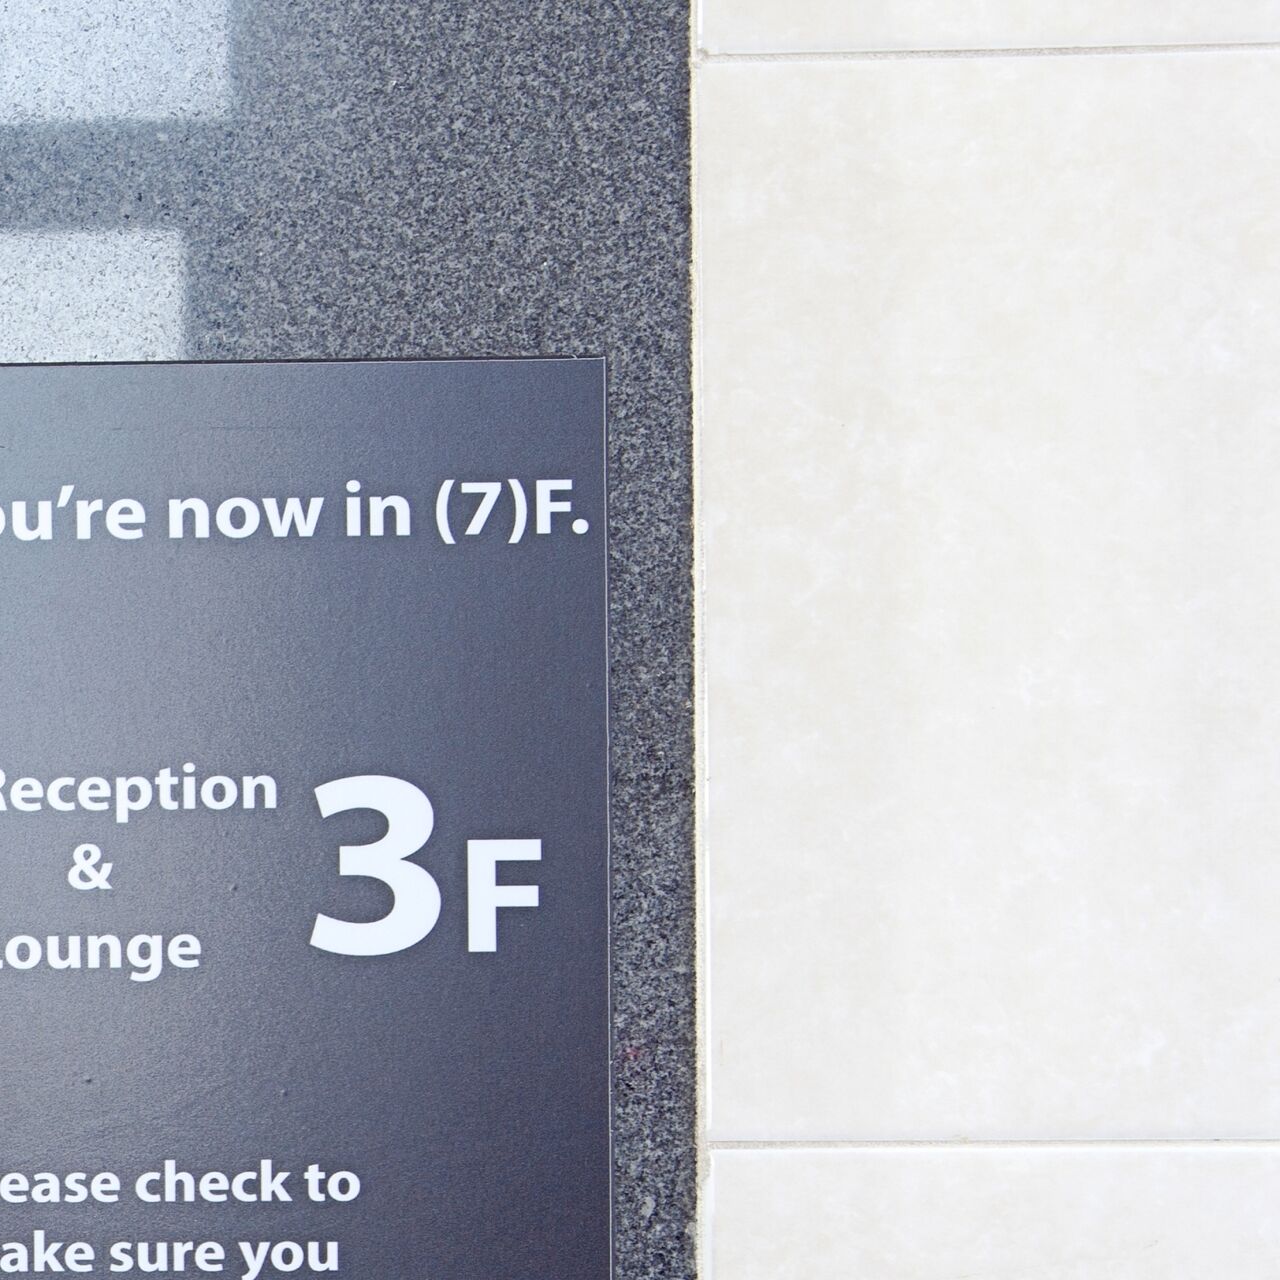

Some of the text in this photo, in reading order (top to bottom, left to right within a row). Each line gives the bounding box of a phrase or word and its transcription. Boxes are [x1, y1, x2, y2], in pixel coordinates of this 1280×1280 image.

[168, 497, 324, 539] now
[345, 480, 411, 537] in
[435, 478, 590, 545] (7)F.
[67, 843, 113, 890] &
[134, 1158, 293, 1203] check
[303, 1163, 361, 1202] to
[109, 1240, 226, 1273] sure
